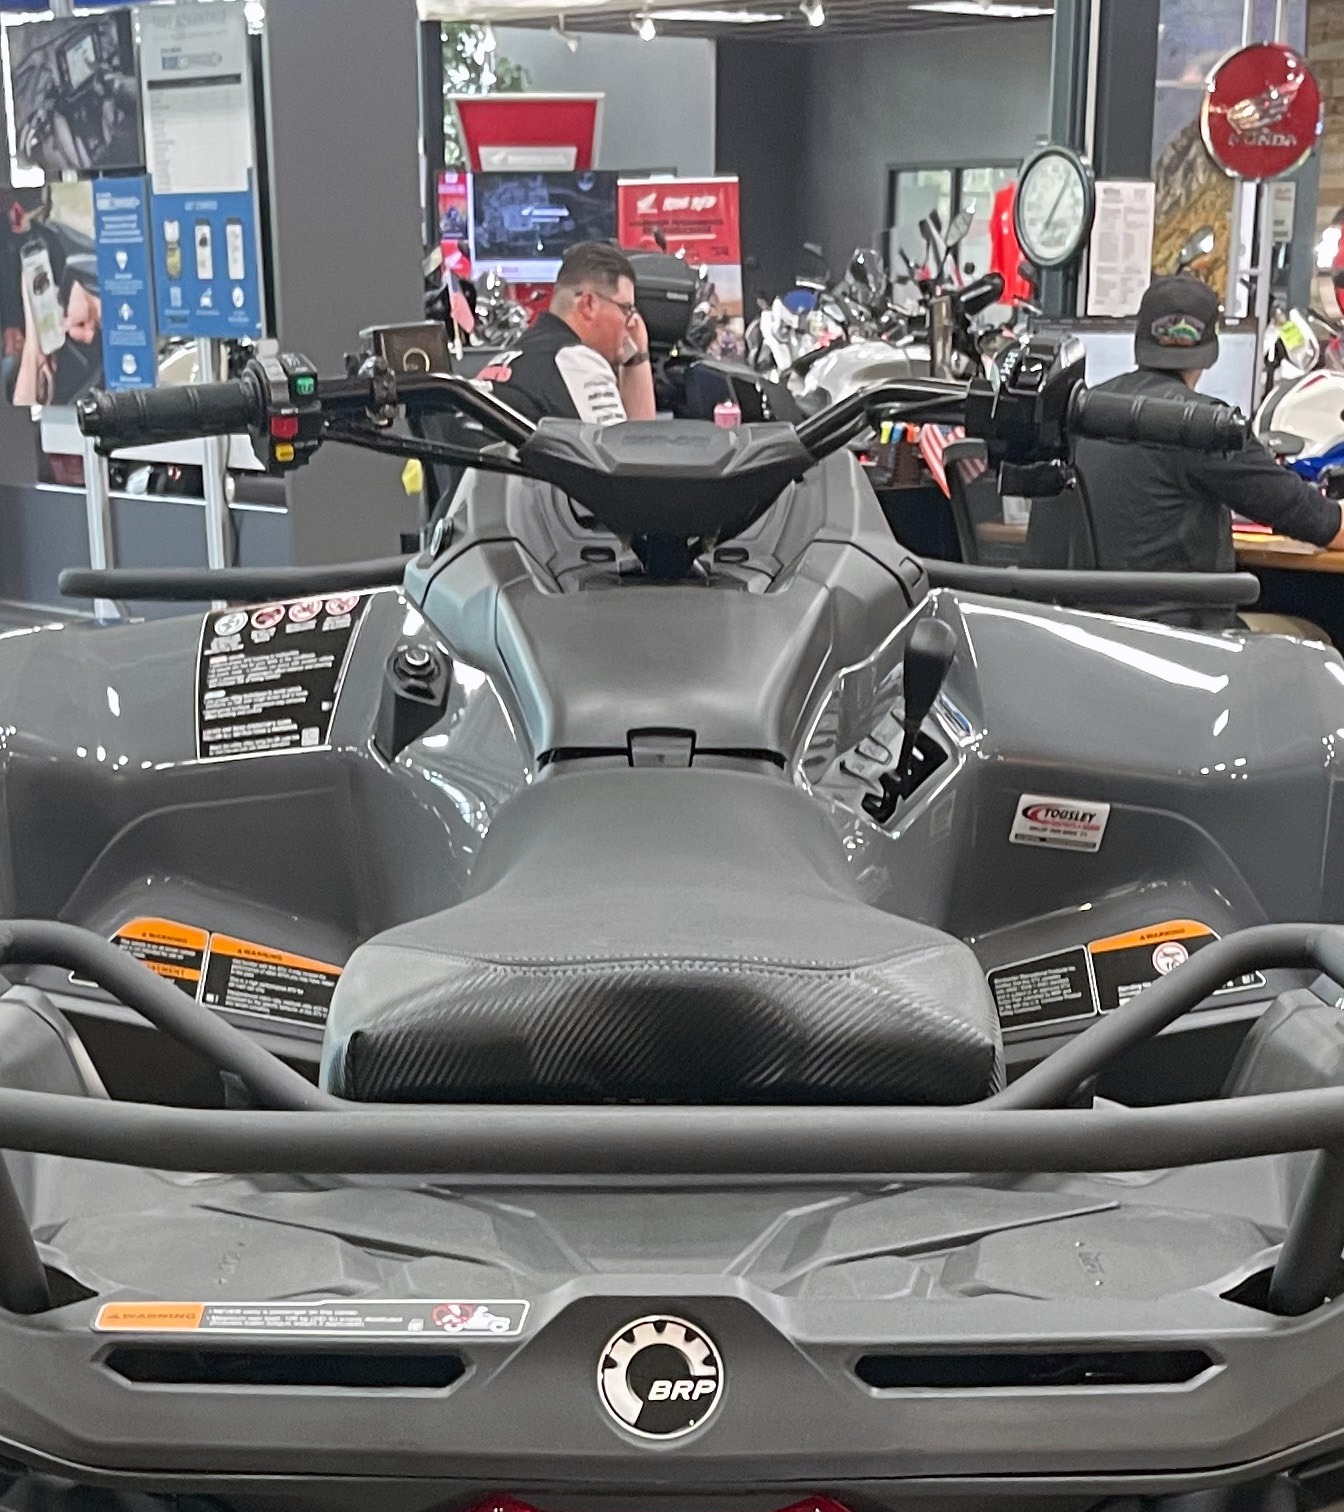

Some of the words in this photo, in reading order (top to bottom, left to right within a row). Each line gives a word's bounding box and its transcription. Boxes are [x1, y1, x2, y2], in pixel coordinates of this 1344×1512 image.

[1043, 807, 1097, 824] TOUSLEY
[122, 1312, 196, 1320] WARNING
[647, 1379, 717, 1401] BRP
